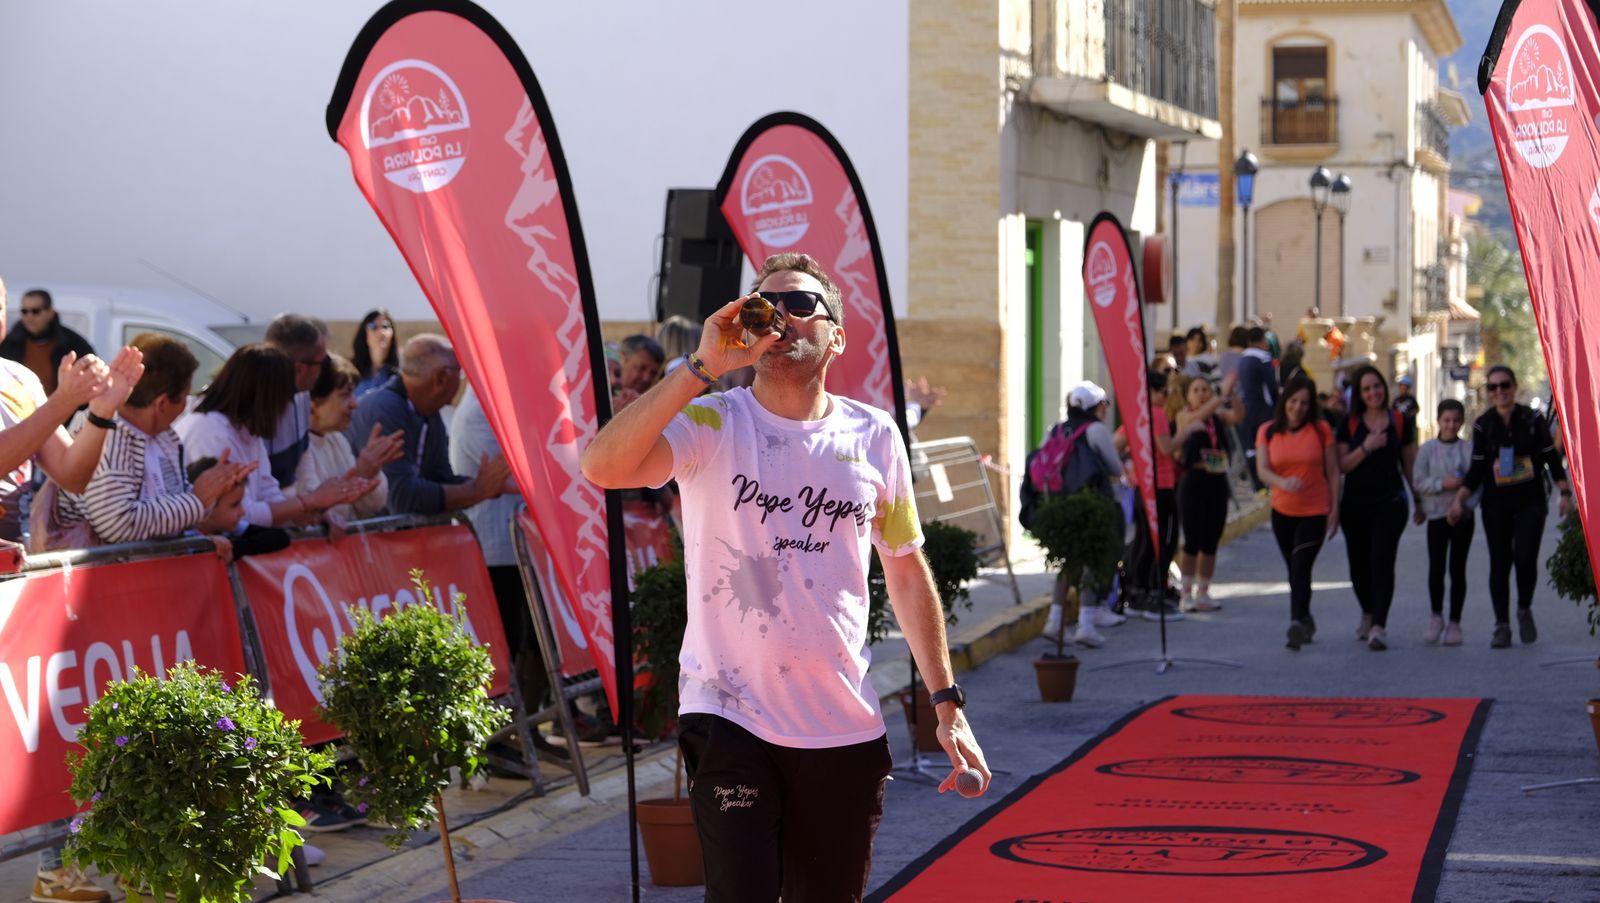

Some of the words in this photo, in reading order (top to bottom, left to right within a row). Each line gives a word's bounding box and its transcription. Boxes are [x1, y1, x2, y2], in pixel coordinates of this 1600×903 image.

[731, 474, 794, 525] Pepe
[798, 486, 870, 533] Yepes
[773, 533, 830, 556] speaker
[714, 786, 735, 799] Pepe
[720, 797, 754, 812] Speaker
